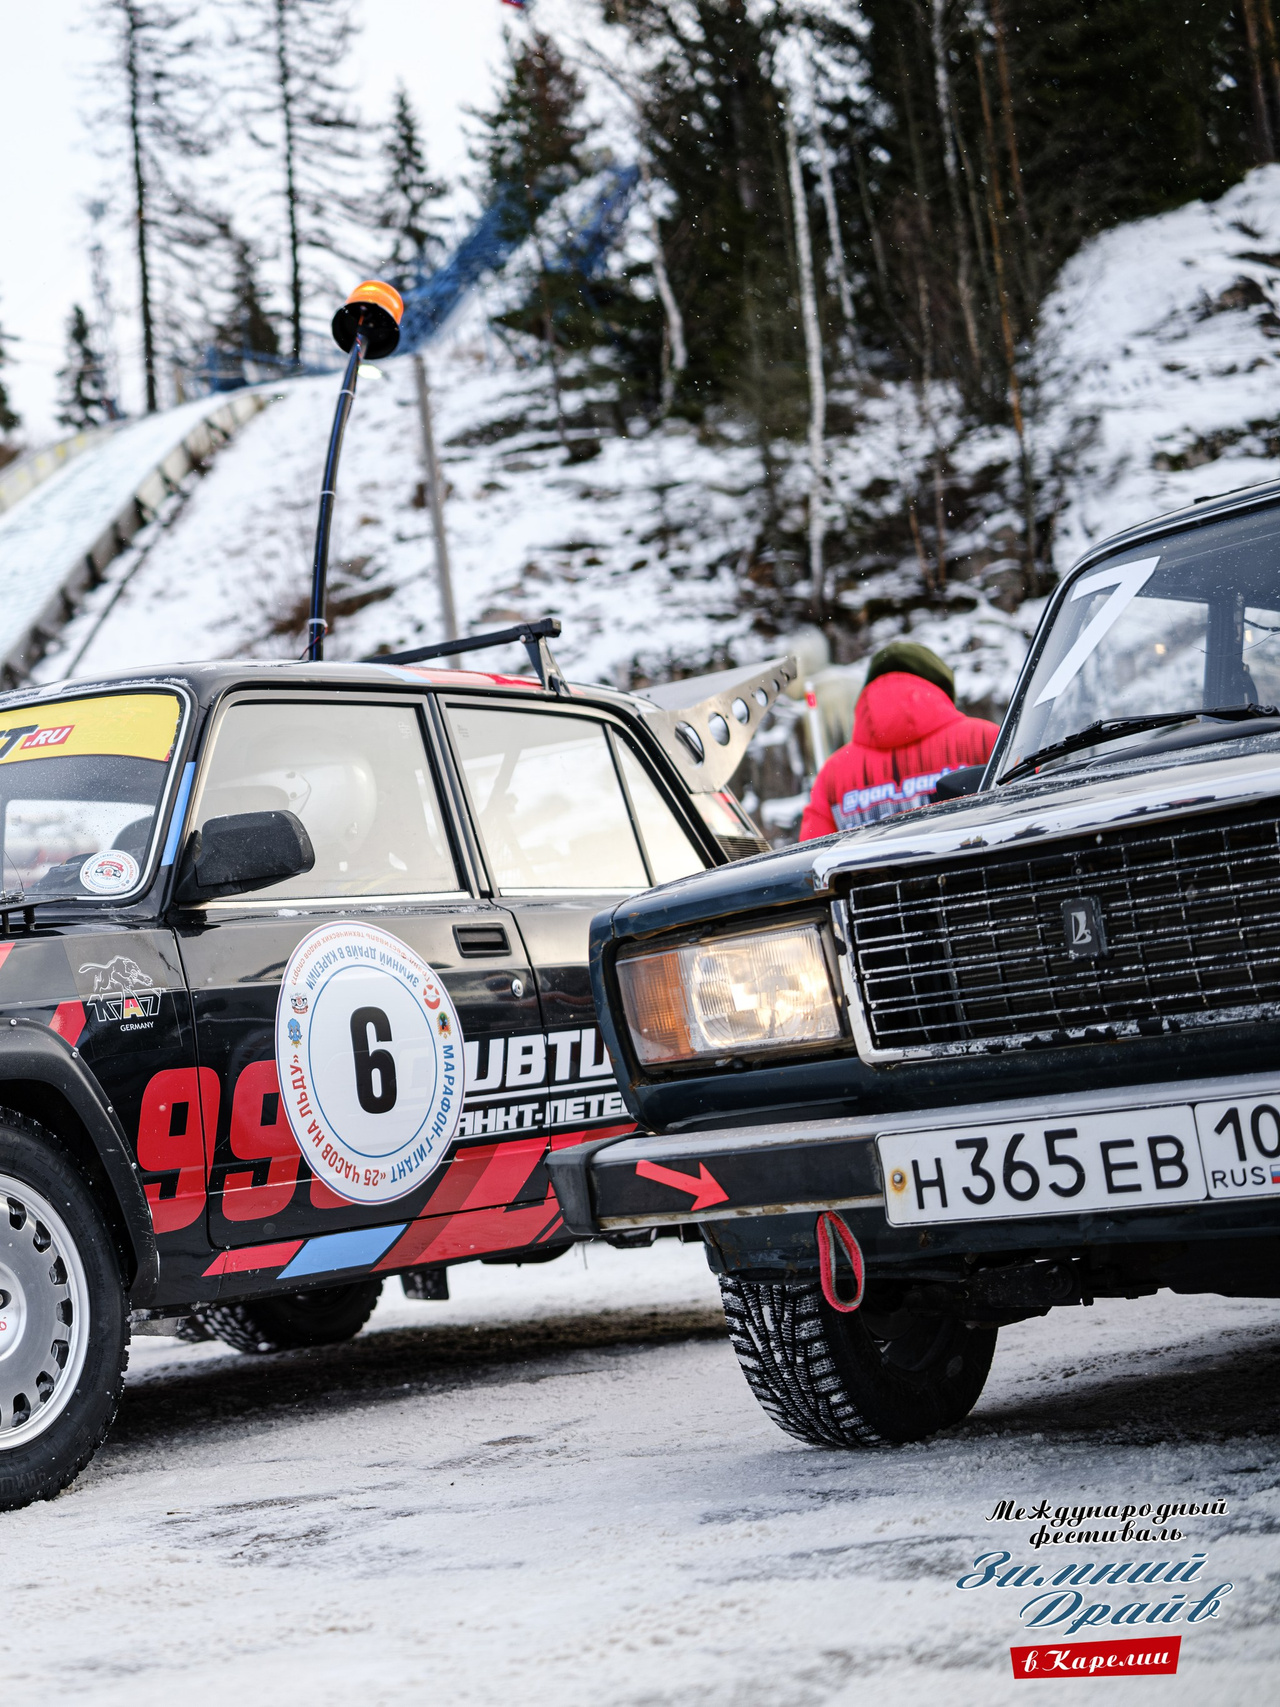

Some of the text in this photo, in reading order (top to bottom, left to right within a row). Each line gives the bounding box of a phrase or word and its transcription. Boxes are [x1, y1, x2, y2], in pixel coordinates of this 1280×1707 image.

[1033, 555, 1161, 707] 7
[305, 941, 322, 960] видов
[321, 930, 365, 946] технических
[305, 945, 420, 990] ЗИМНИЙ ДРАЙВ В КАРЕЛИИ
[120, 1021, 154, 1031] GERMANY
[350, 1006, 397, 1115] 6
[306, 1118, 325, 1148] НА
[390, 1044, 455, 1183] МАРАФОН-ГИГАНТ
[456, 1092, 628, 1137] АНКТ-ПЕТЕ
[137, 1060, 356, 1234] 99
[321, 1142, 360, 1184] ЧАСОВ
[1211, 1166, 1267, 1189] RUS
